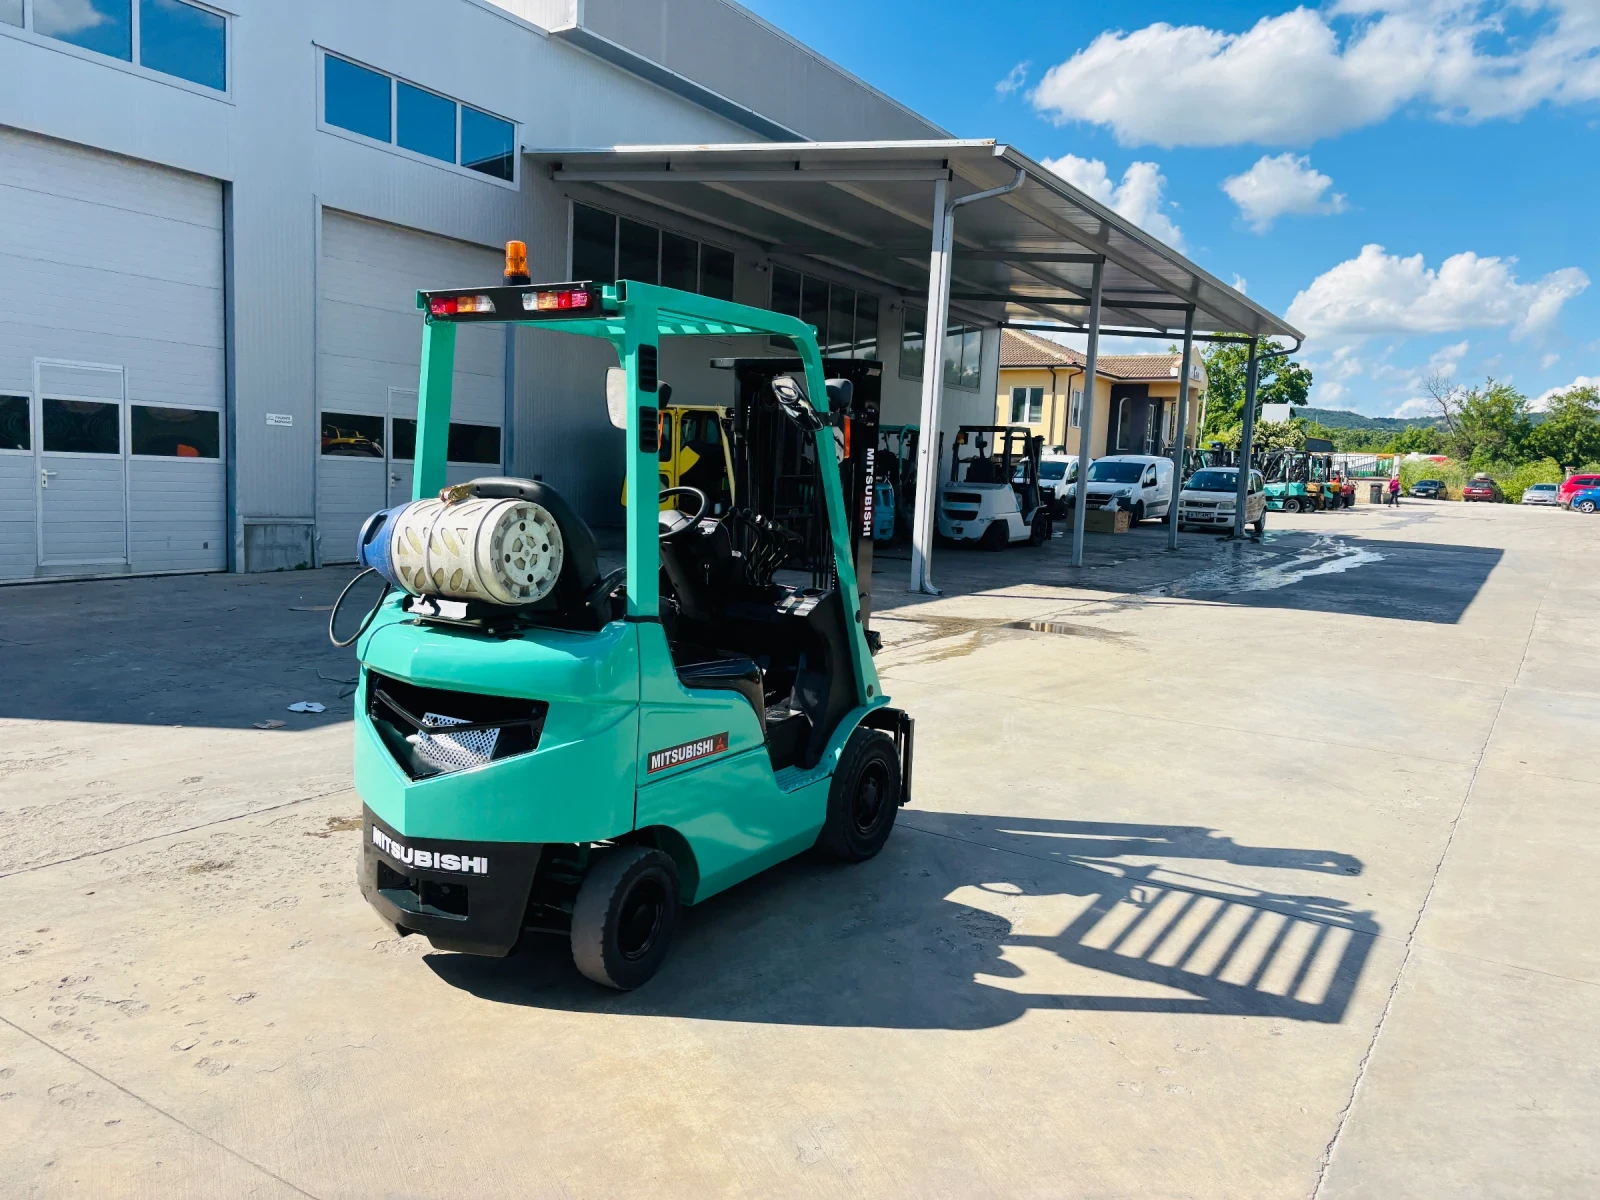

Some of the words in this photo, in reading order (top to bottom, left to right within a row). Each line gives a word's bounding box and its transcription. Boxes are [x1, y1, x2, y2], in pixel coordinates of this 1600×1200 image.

[863, 448, 875, 536] MITSUBISHI
[651, 739, 713, 769] MITSUBISHI
[372, 825, 488, 874] MITSUBISHI
